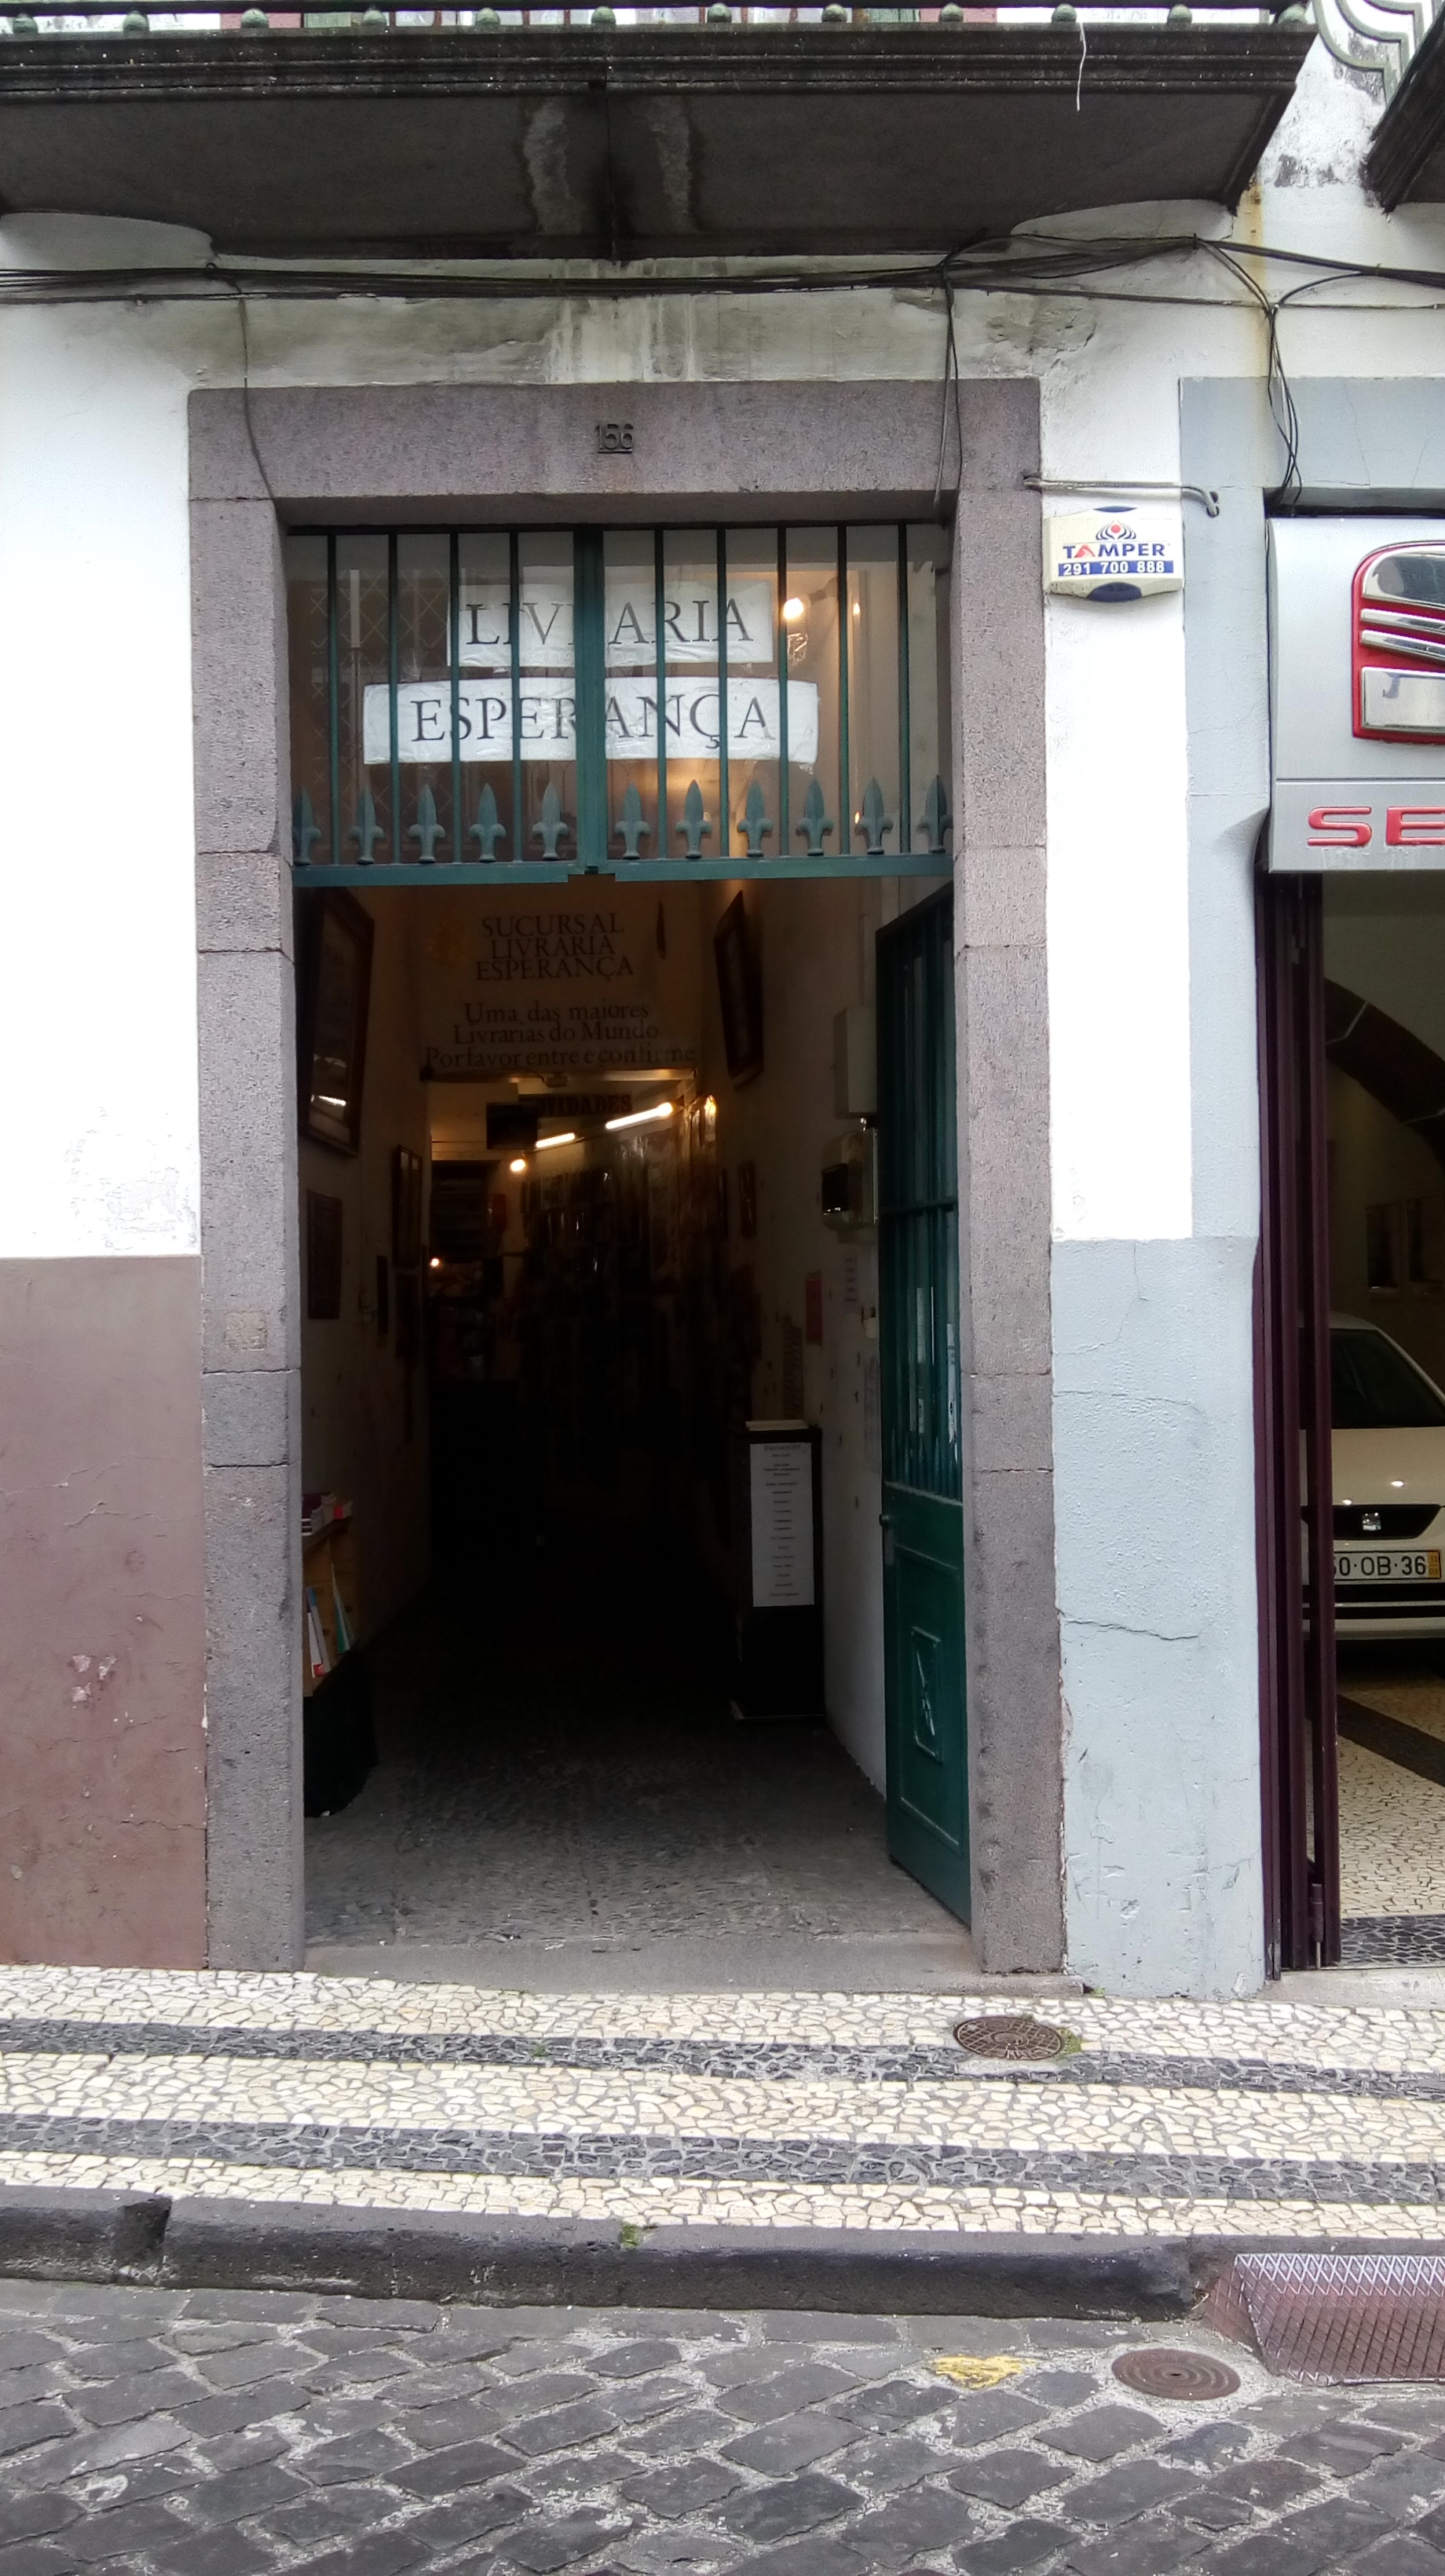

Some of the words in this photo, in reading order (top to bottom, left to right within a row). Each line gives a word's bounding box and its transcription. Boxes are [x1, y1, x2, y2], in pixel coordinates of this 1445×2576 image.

[594, 423, 635, 451] 156
[1063, 543, 1165, 559] TAMPER
[1063, 562, 1092, 576] 291
[1100, 561, 1129, 574] 700
[1136, 560, 1165, 573] 888
[466, 597, 754, 646] LVARIA
[481, 912, 625, 939] SUCURSAL
[490, 935, 616, 961] LIVRARIA
[476, 956, 635, 982] ESPERANÇA
[463, 1002, 518, 1023] Uma
[527, 1000, 561, 1022] das
[569, 997, 649, 1020] maiores
[452, 1021, 545, 1045] Livrarias
[549, 1020, 576, 1042] do
[581, 1019, 660, 1041] Mundo
[525, 1049, 580, 1066] entre
[583, 1050, 595, 1064] e
